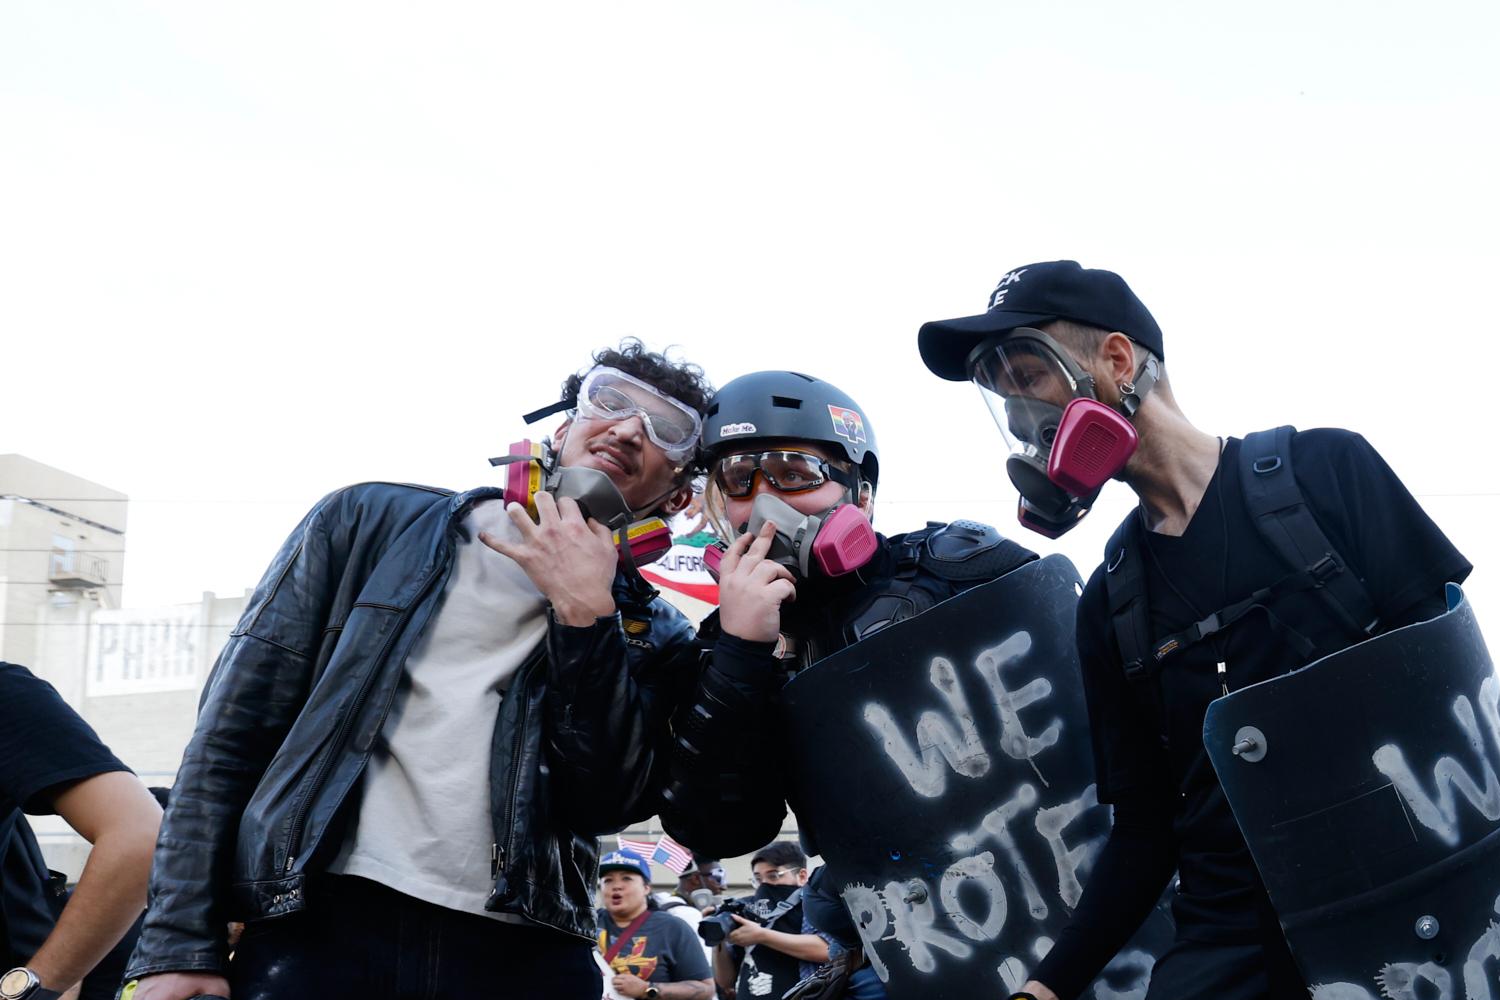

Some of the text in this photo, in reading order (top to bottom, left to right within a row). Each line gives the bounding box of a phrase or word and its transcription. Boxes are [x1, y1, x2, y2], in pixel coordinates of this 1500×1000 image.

[995, 268, 1028, 290] CK
[864, 631, 1062, 798] WE
[841, 783, 1114, 983] PROTE
